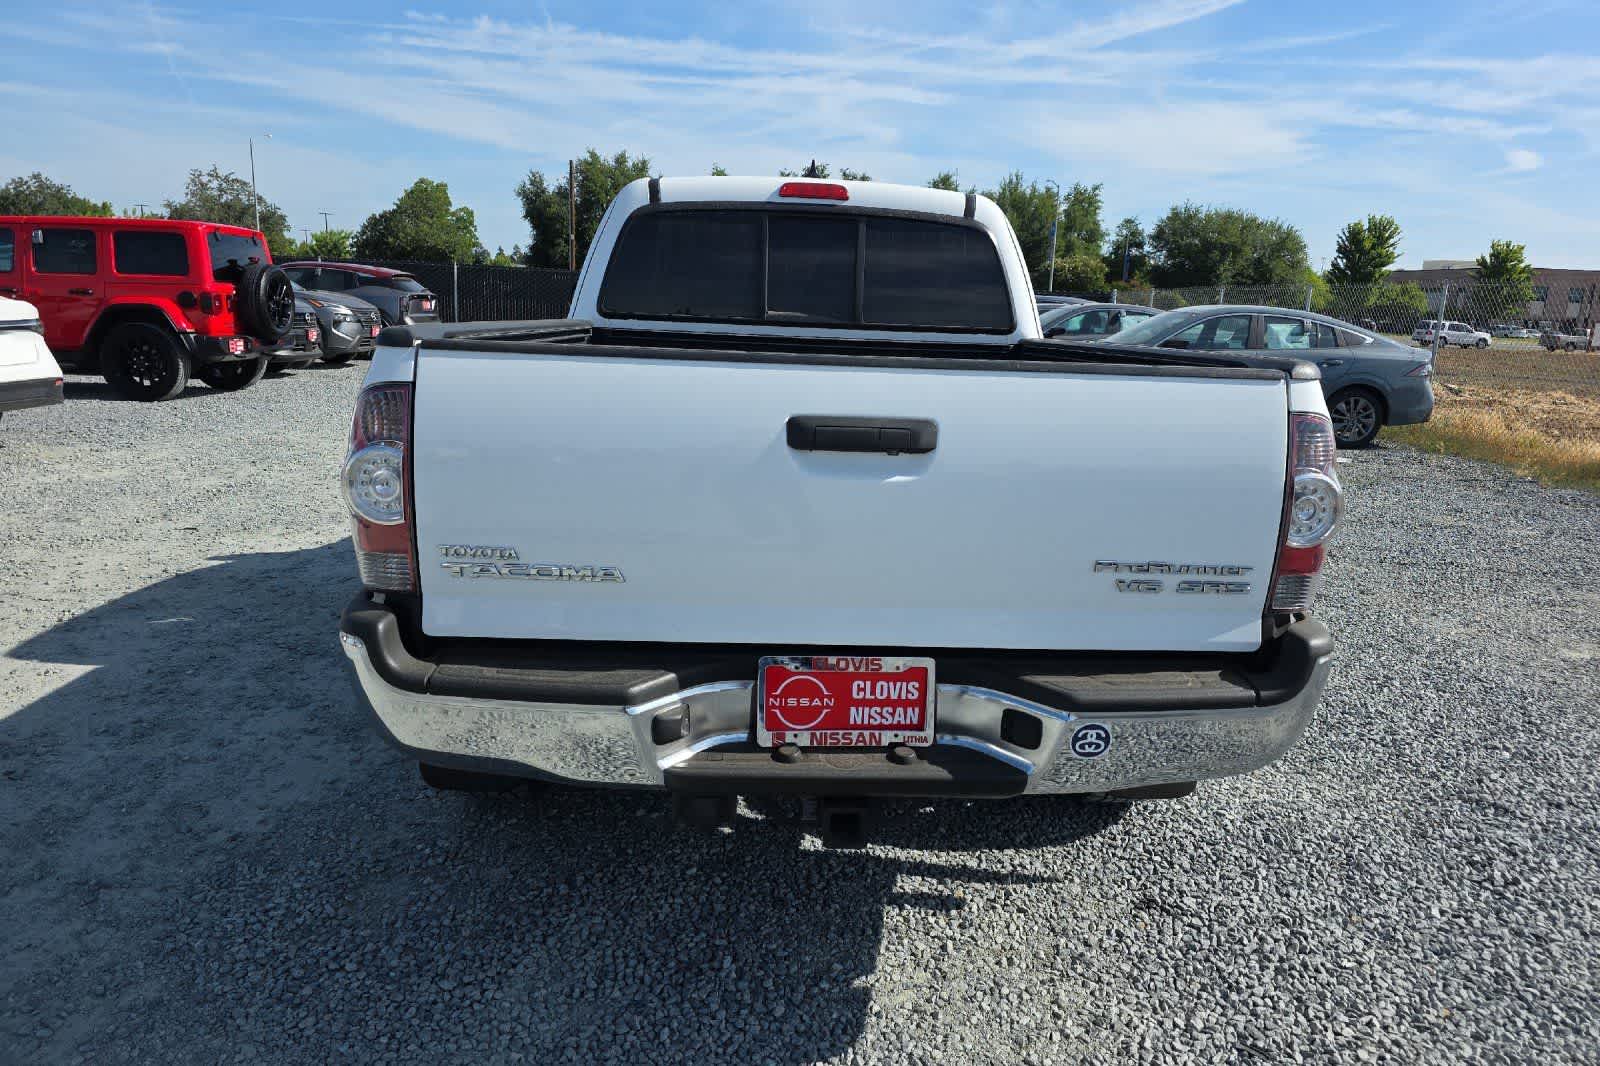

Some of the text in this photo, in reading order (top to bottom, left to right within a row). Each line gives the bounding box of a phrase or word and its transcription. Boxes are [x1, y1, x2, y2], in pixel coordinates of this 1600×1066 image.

[439, 544, 519, 560] TOYOTA
[440, 562, 625, 583] TACOMA
[1094, 560, 1253, 576] PreRunner
[1115, 579, 1164, 593] V6
[812, 657, 883, 671] CLOVIS
[852, 680, 920, 700] CLOVIS
[769, 697, 835, 707] NISSAN
[849, 706, 920, 725] NISSAN
[809, 731, 882, 746] NISSAN
